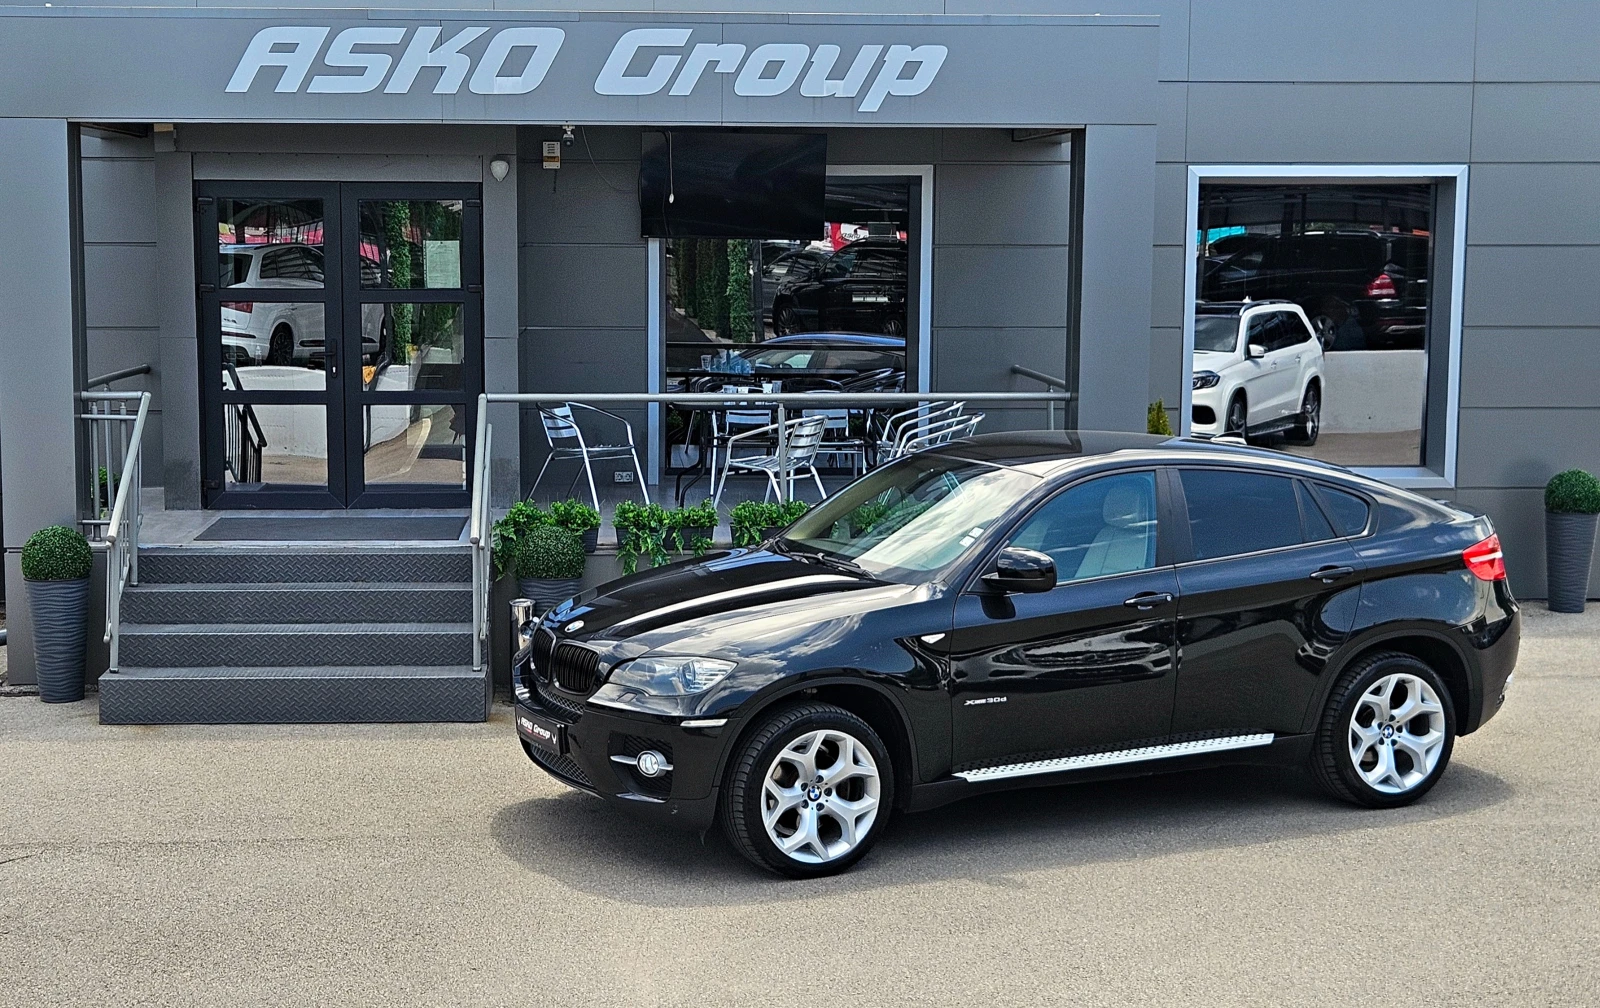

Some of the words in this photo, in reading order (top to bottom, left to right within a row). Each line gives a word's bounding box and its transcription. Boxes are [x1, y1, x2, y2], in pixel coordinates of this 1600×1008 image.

[225, 27, 566, 95] ASKO
[594, 29, 949, 113] Group
[534, 724, 551, 740] Group
